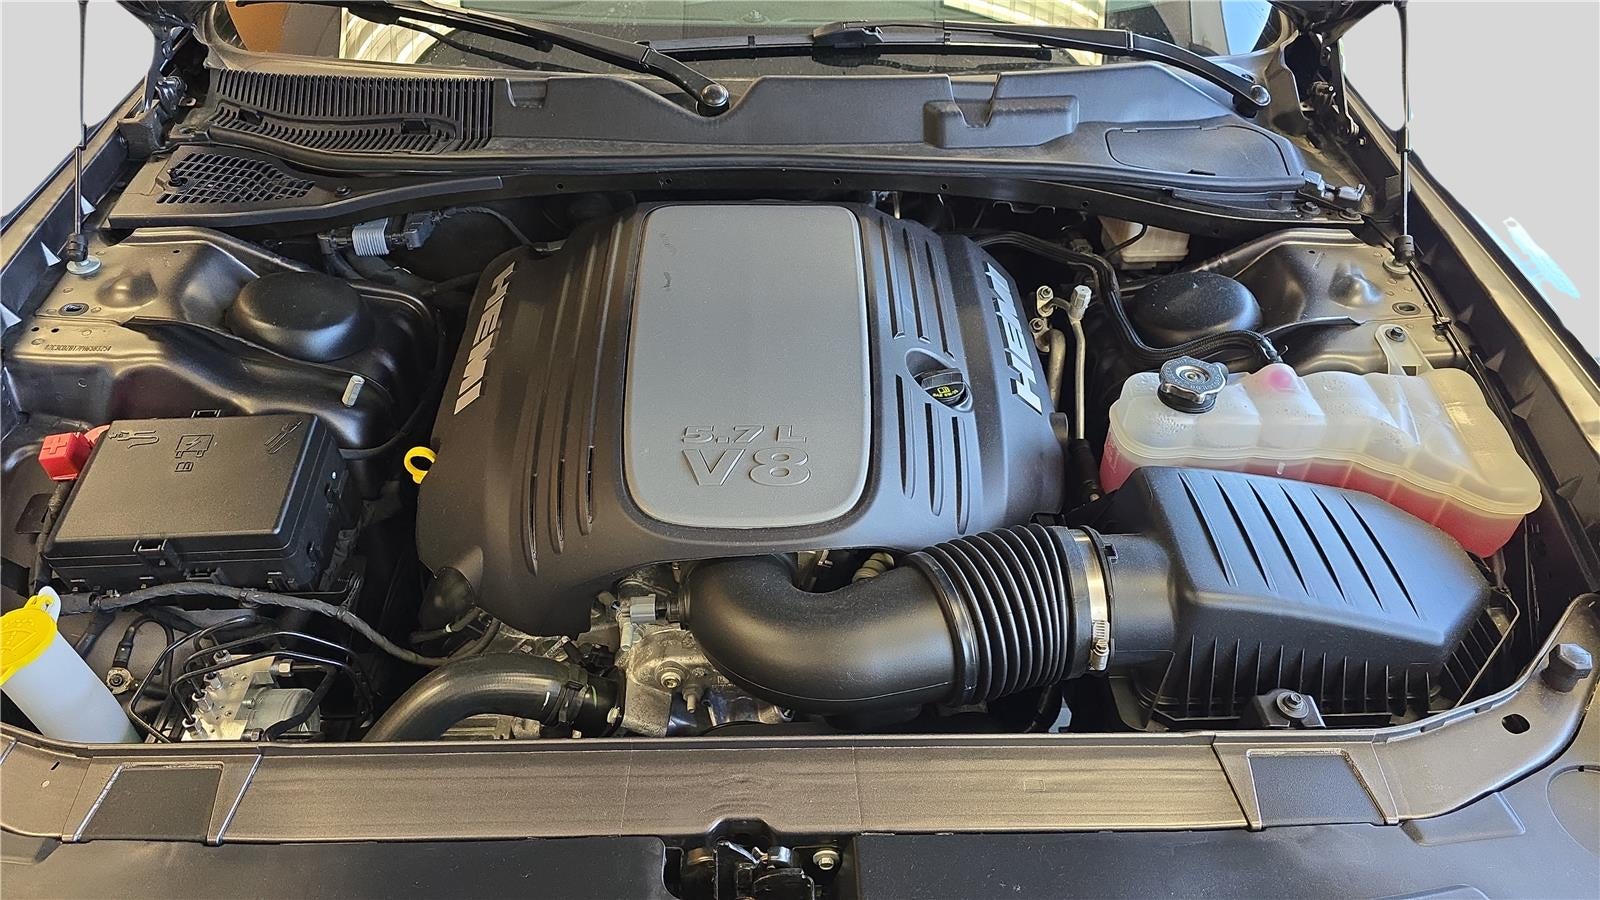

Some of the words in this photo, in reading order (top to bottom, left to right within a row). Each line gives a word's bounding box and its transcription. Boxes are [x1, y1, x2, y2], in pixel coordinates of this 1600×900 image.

[454, 261, 516, 415] HEMI
[985, 262, 1042, 416] HEMI
[681, 424, 764, 444] 5.7
[776, 424, 807, 443] L
[681, 447, 811, 487] V8
